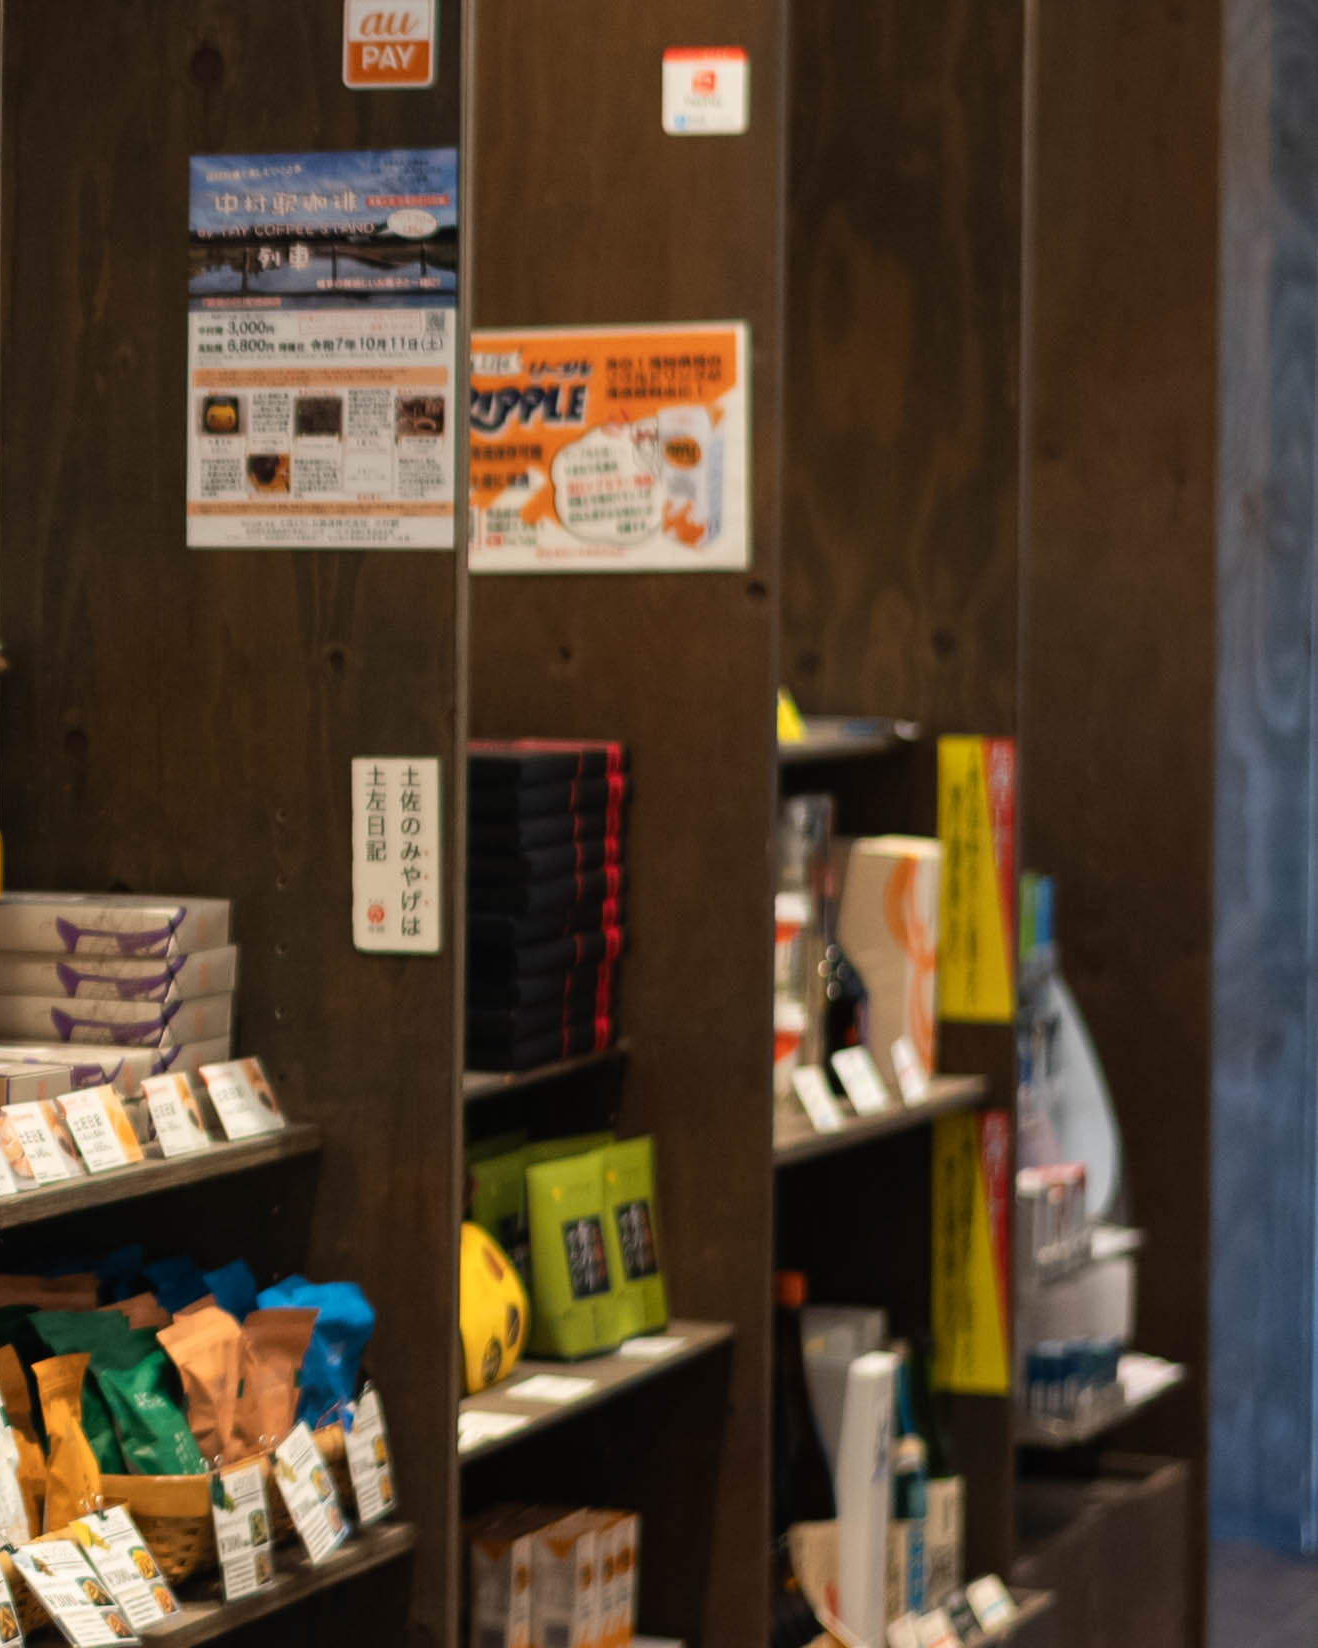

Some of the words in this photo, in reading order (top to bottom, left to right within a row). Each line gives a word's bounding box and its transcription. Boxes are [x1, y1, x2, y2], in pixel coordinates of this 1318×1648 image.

[359, 8, 423, 39] au
[361, 44, 416, 73] PAY
[365, 764, 387, 863] 土左日記
[399, 764, 422, 936] 土佐のみやげは
